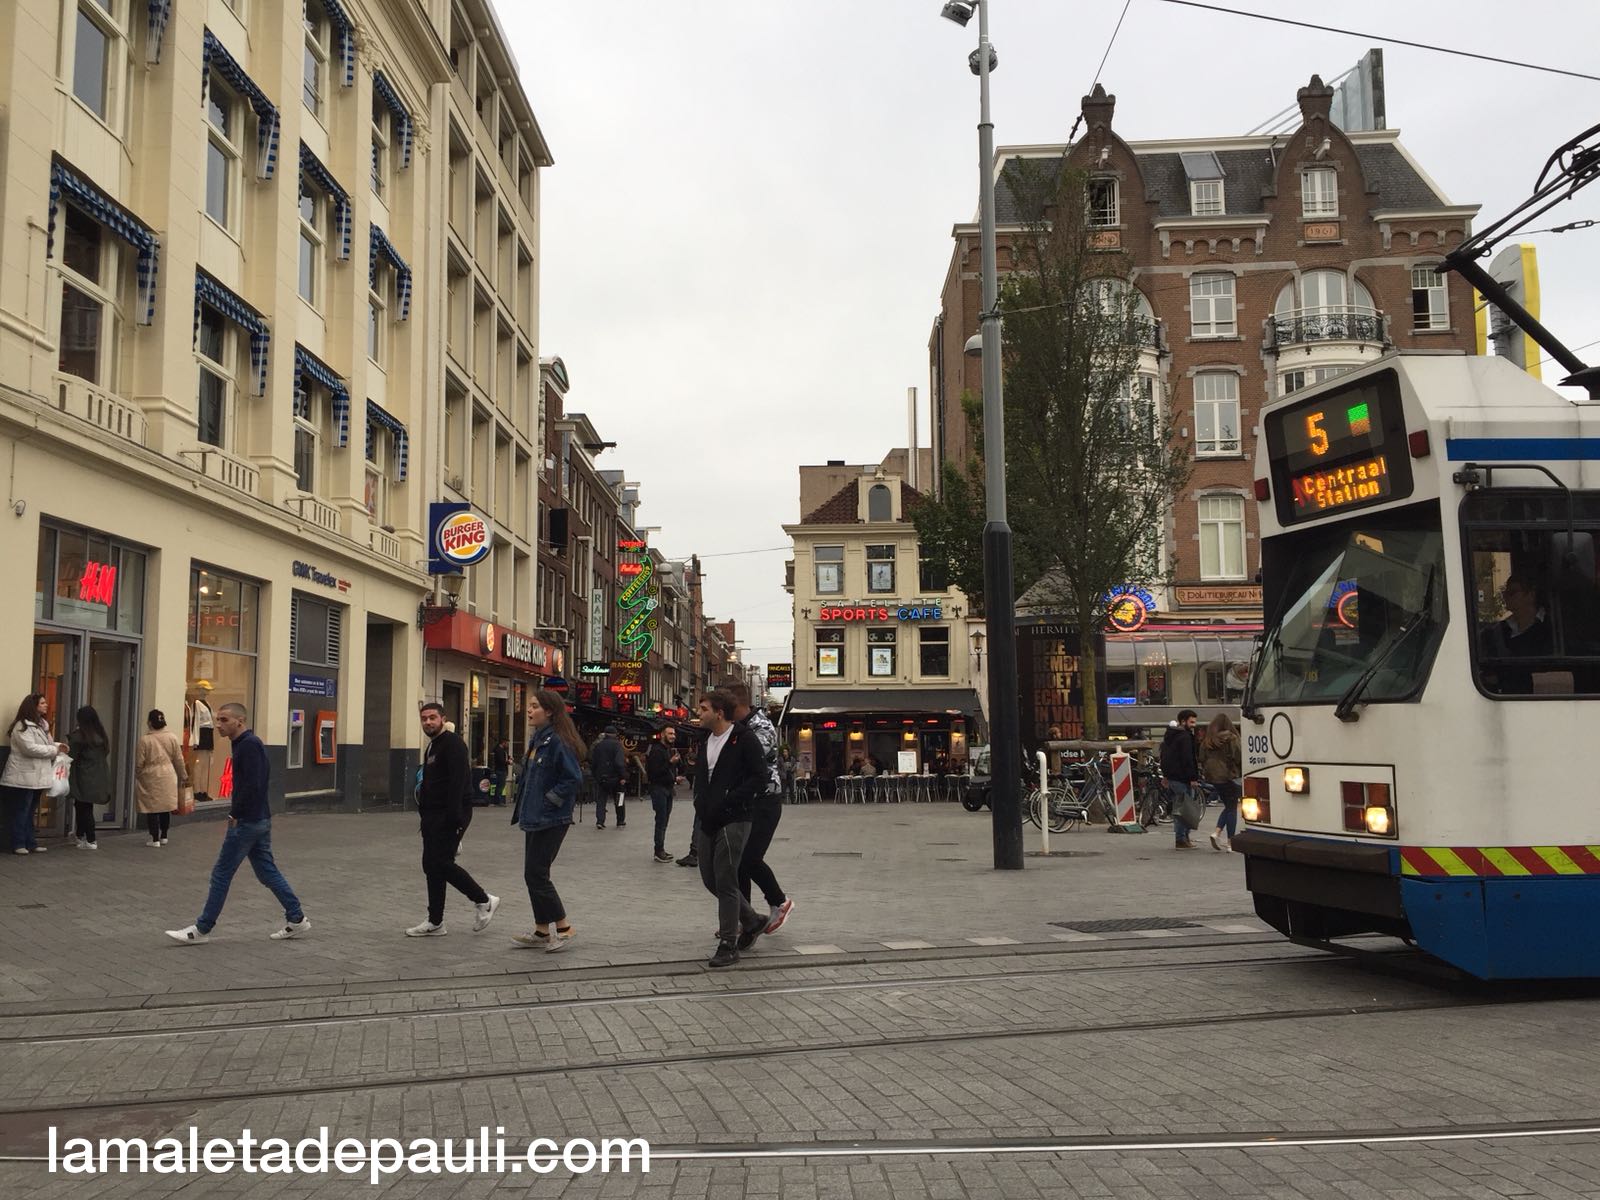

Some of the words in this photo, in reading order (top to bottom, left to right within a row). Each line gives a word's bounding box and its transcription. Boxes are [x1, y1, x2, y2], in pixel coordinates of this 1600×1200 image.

[1307, 411, 1330, 456] 5
[1303, 456, 1386, 495] Centraal
[1316, 480, 1380, 508] Station
[443, 521, 484, 540] BURGER
[445, 530, 485, 552] KING
[80, 561, 117, 607] H&M
[1187, 590, 1248, 600] POLITIEBUREAU
[820, 608, 888, 621] SPORTS
[897, 607, 943, 621] CAFE
[821, 598, 942, 608] SATELLITE
[594, 593, 602, 657] RANCHO
[506, 633, 532, 664] BURGER
[532, 642, 547, 668] KING
[1248, 735, 1268, 753] 908
